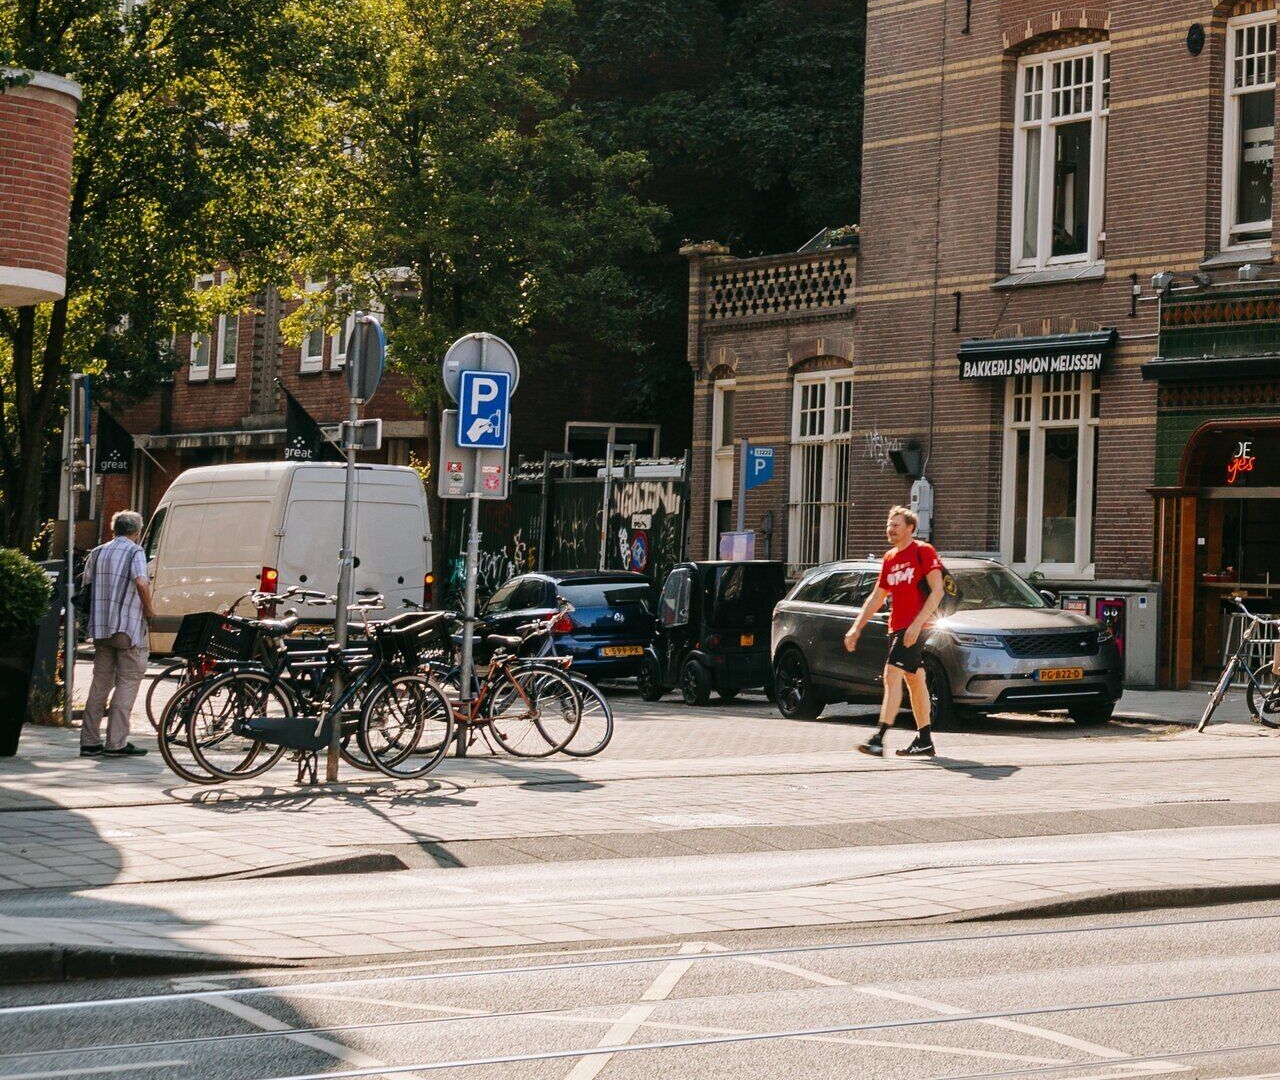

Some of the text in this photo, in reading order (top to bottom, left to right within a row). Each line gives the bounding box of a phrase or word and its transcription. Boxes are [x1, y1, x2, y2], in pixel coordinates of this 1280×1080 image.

[963, 353, 1102, 377] BAKKERIJ SIMON MEIJSSEN
[471, 377, 499, 416] P
[284, 447, 313, 460] great
[100, 460, 128, 470] great
[755, 459, 766, 475] P
[604, 646, 640, 656] L-599-PK
[1041, 671, 1080, 680] PG-822-D
